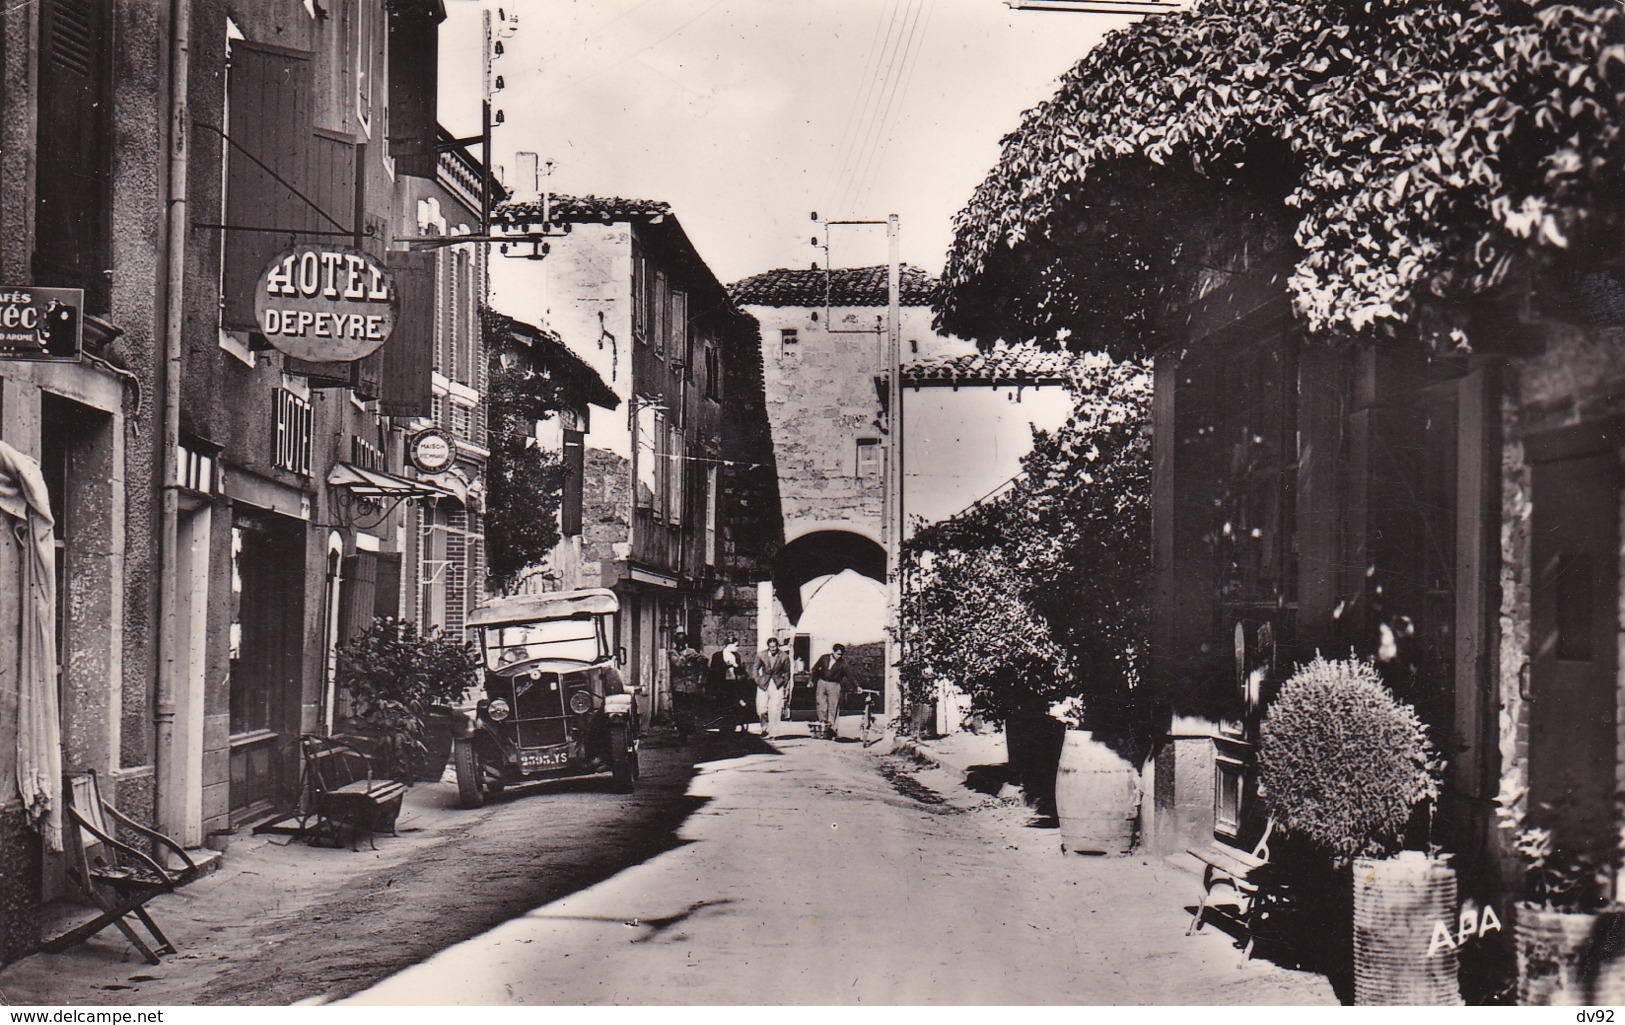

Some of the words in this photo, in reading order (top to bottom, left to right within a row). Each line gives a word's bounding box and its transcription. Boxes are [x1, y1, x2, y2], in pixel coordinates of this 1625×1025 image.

[267, 251, 389, 301] HOTEL
[0, 304, 37, 329] éc
[265, 309, 385, 339] DEPEYRE
[6, 333, 33, 341] AROME
[277, 388, 315, 478] HOTEL
